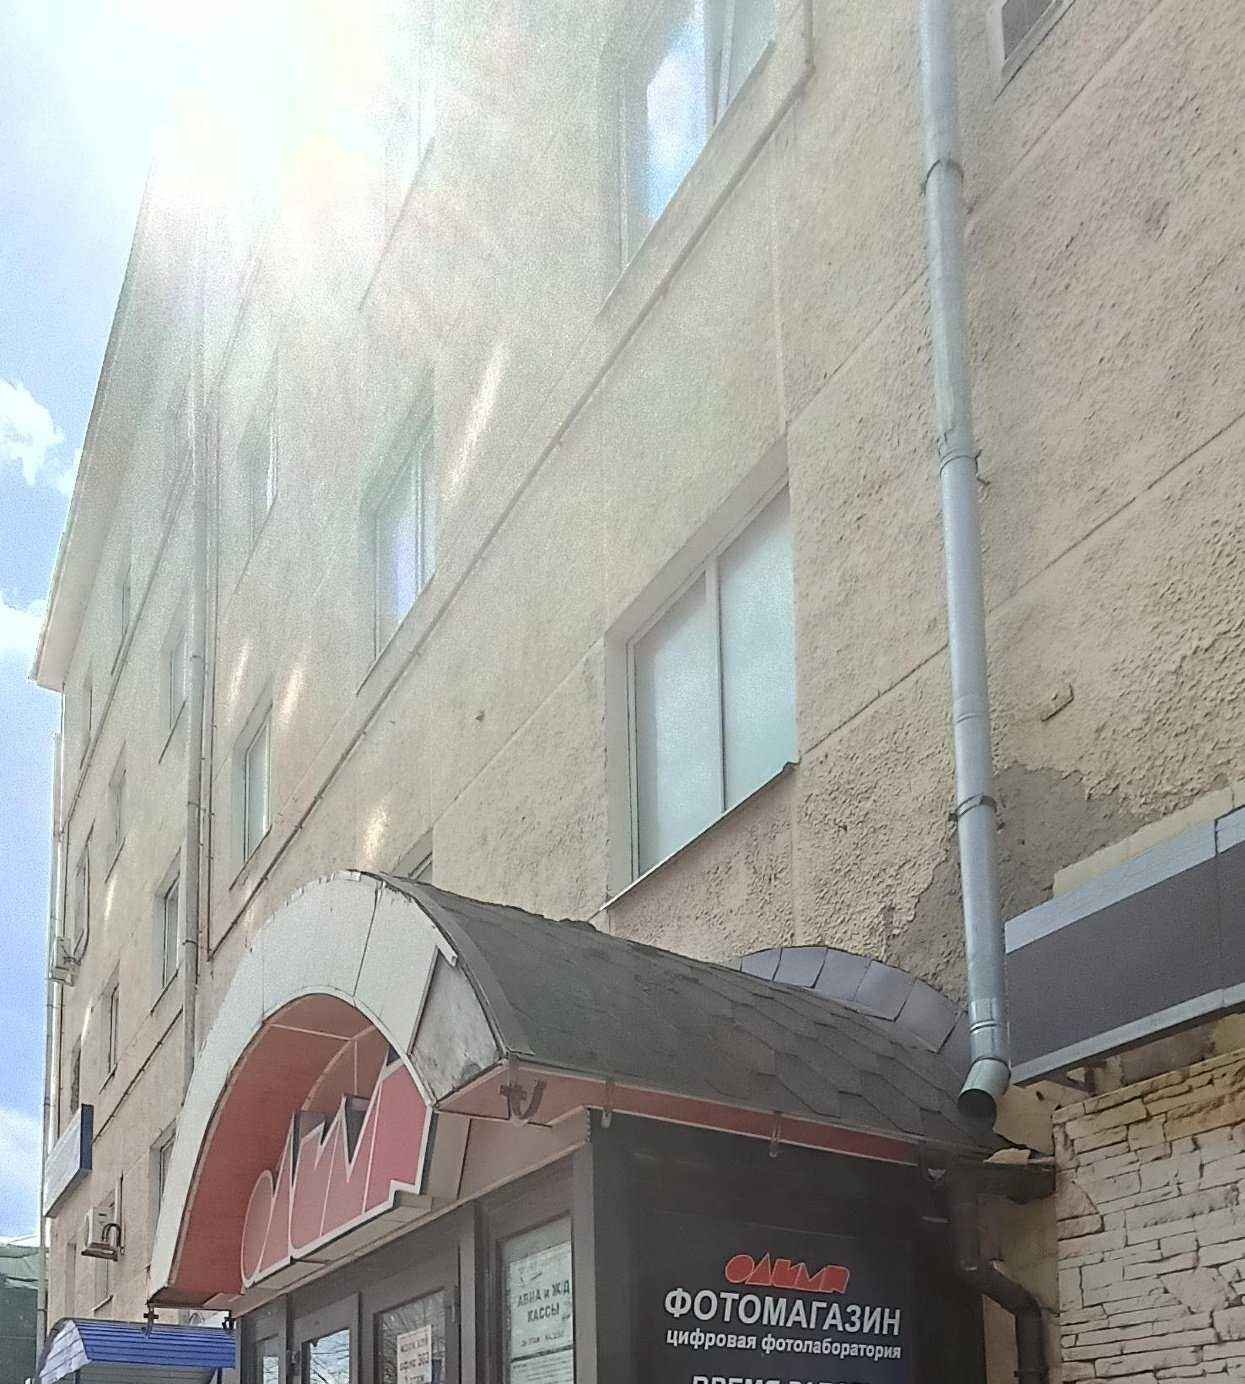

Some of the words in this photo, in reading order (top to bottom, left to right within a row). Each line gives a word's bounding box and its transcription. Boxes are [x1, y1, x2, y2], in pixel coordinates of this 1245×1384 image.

[724, 1252, 850, 1293] ОЛИМП
[527, 1302, 560, 1322] КАССЫ
[664, 1287, 901, 1336] ФОТОМАГАЗИН
[666, 1328, 757, 1350] цифровая
[761, 1334, 901, 1361] фотолаборатория
